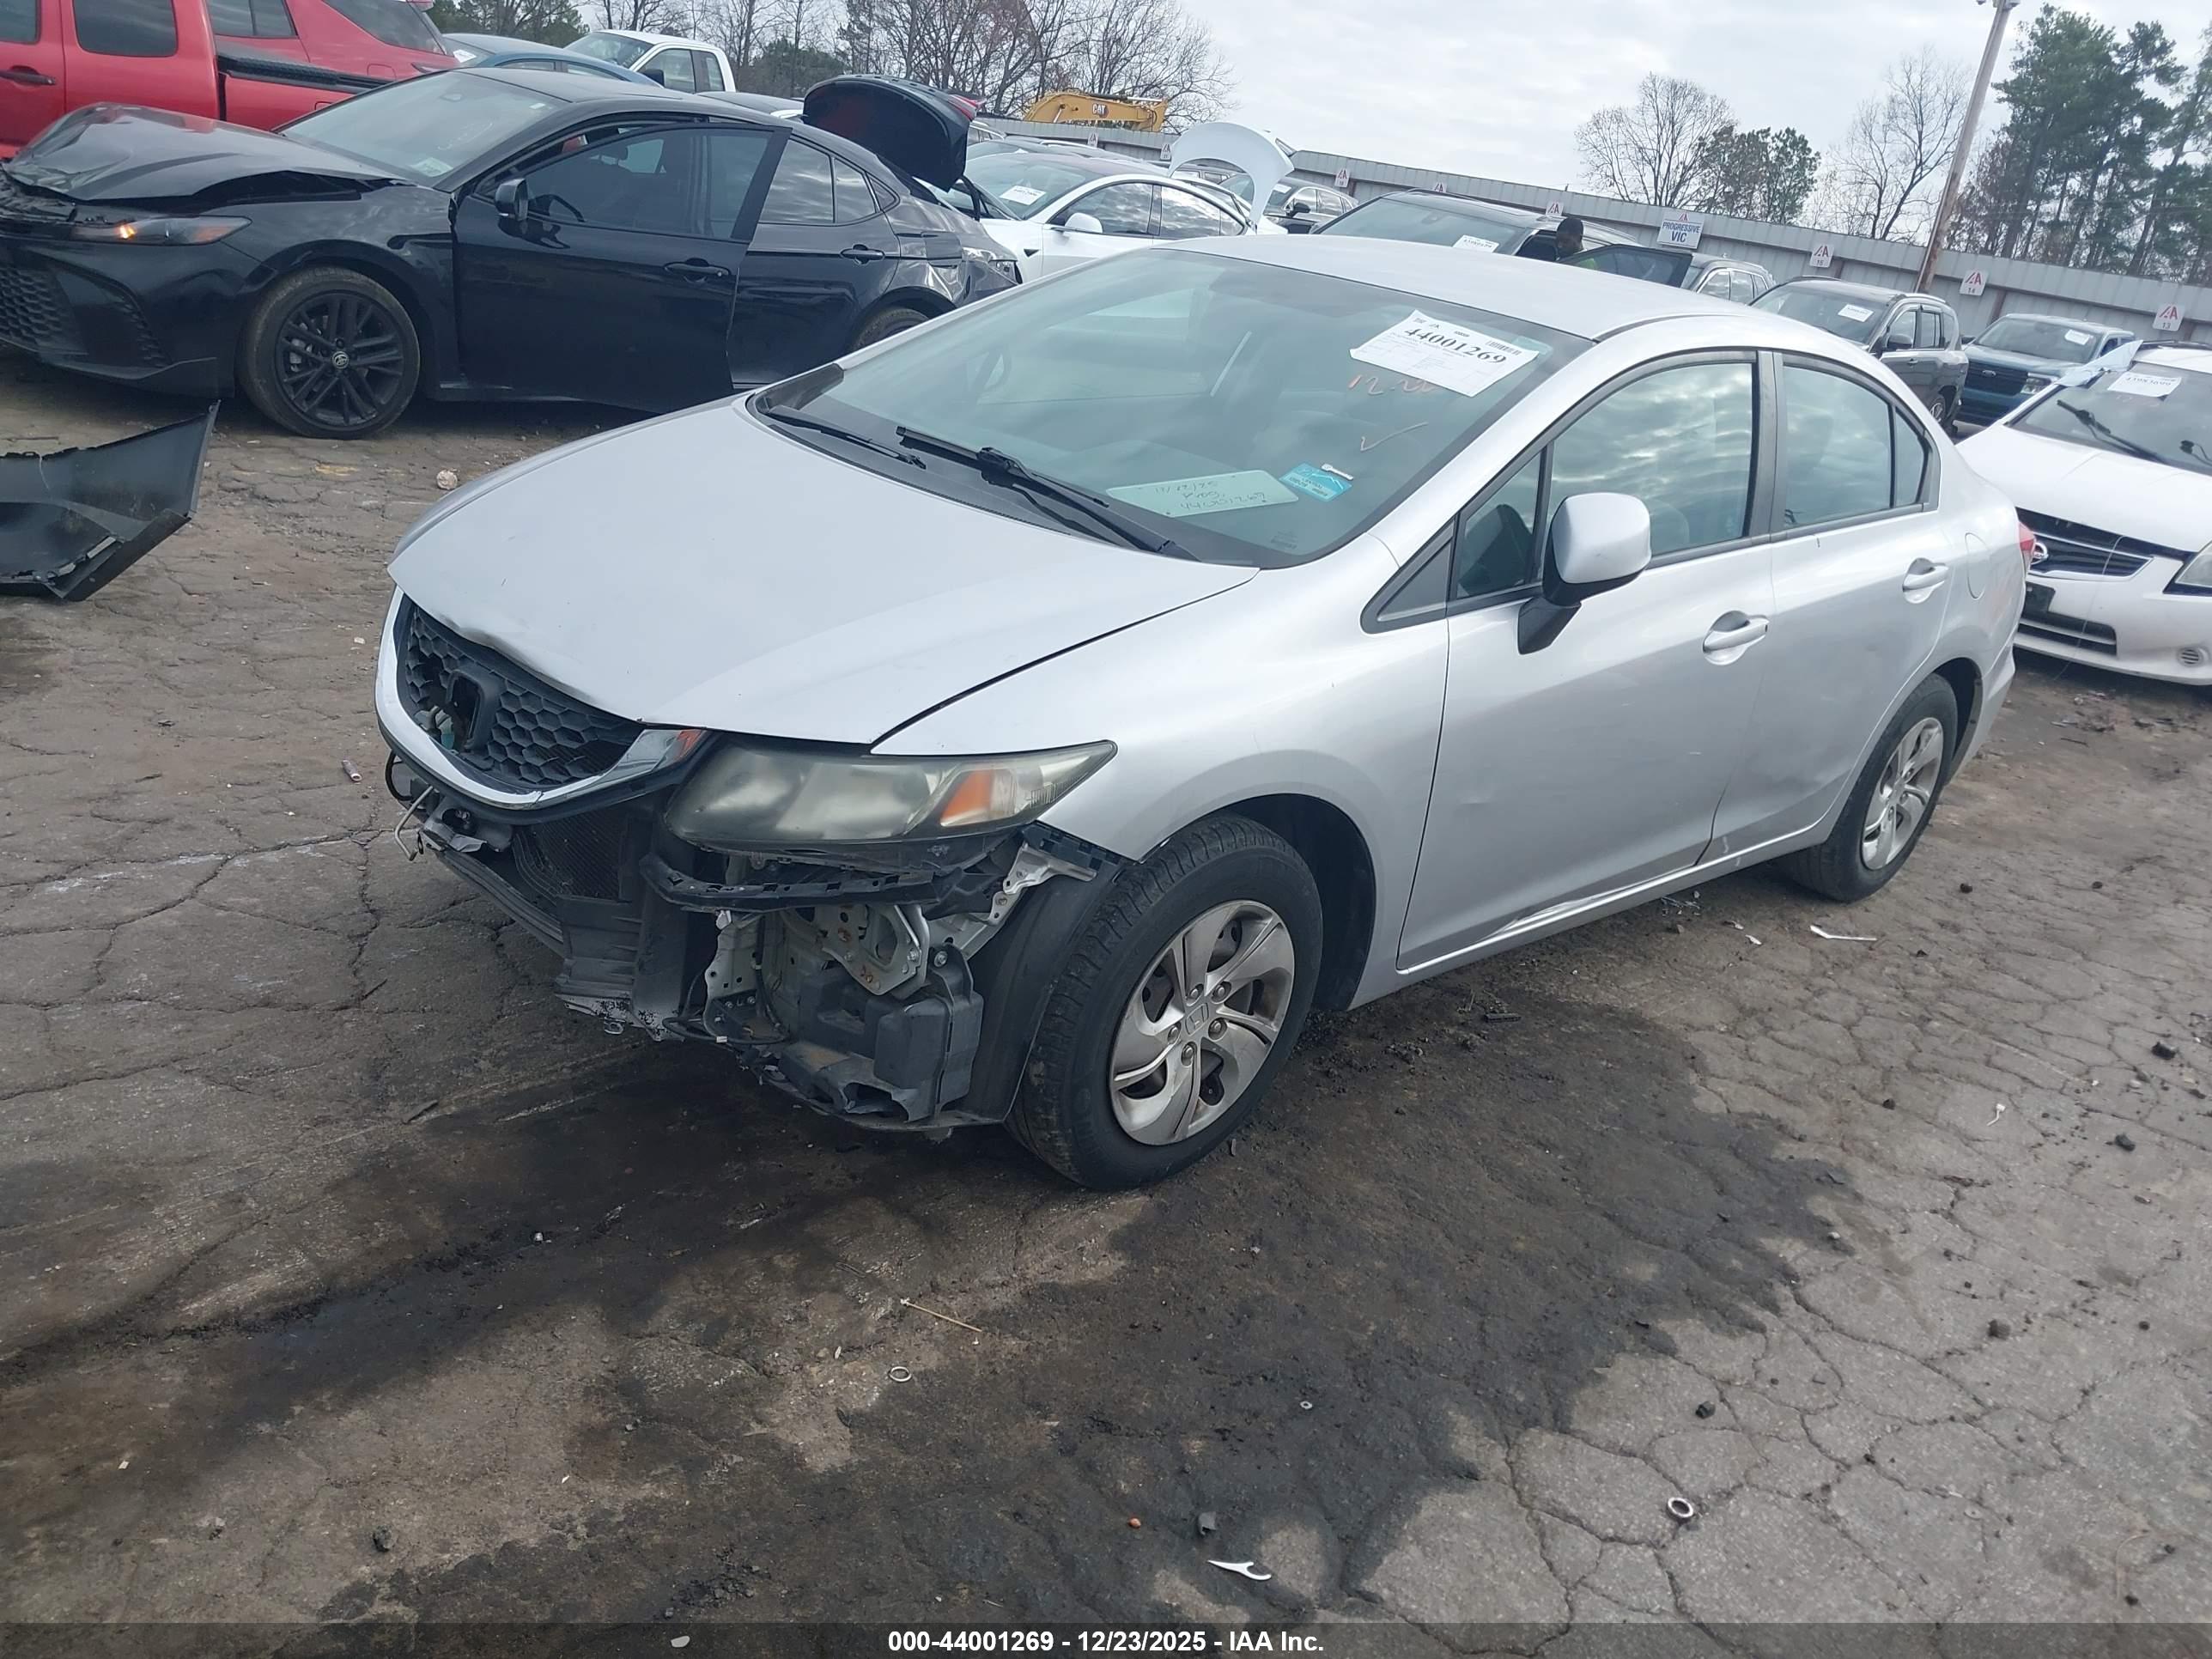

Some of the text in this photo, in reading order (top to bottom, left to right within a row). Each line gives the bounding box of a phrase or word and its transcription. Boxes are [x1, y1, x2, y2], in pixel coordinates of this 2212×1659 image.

[1092, 103, 1106, 115] CAT
[1662, 222, 1701, 234] PROGRESSIVE
[1671, 231, 1687, 243] VIC
[1404, 328, 1507, 363] 44001269
